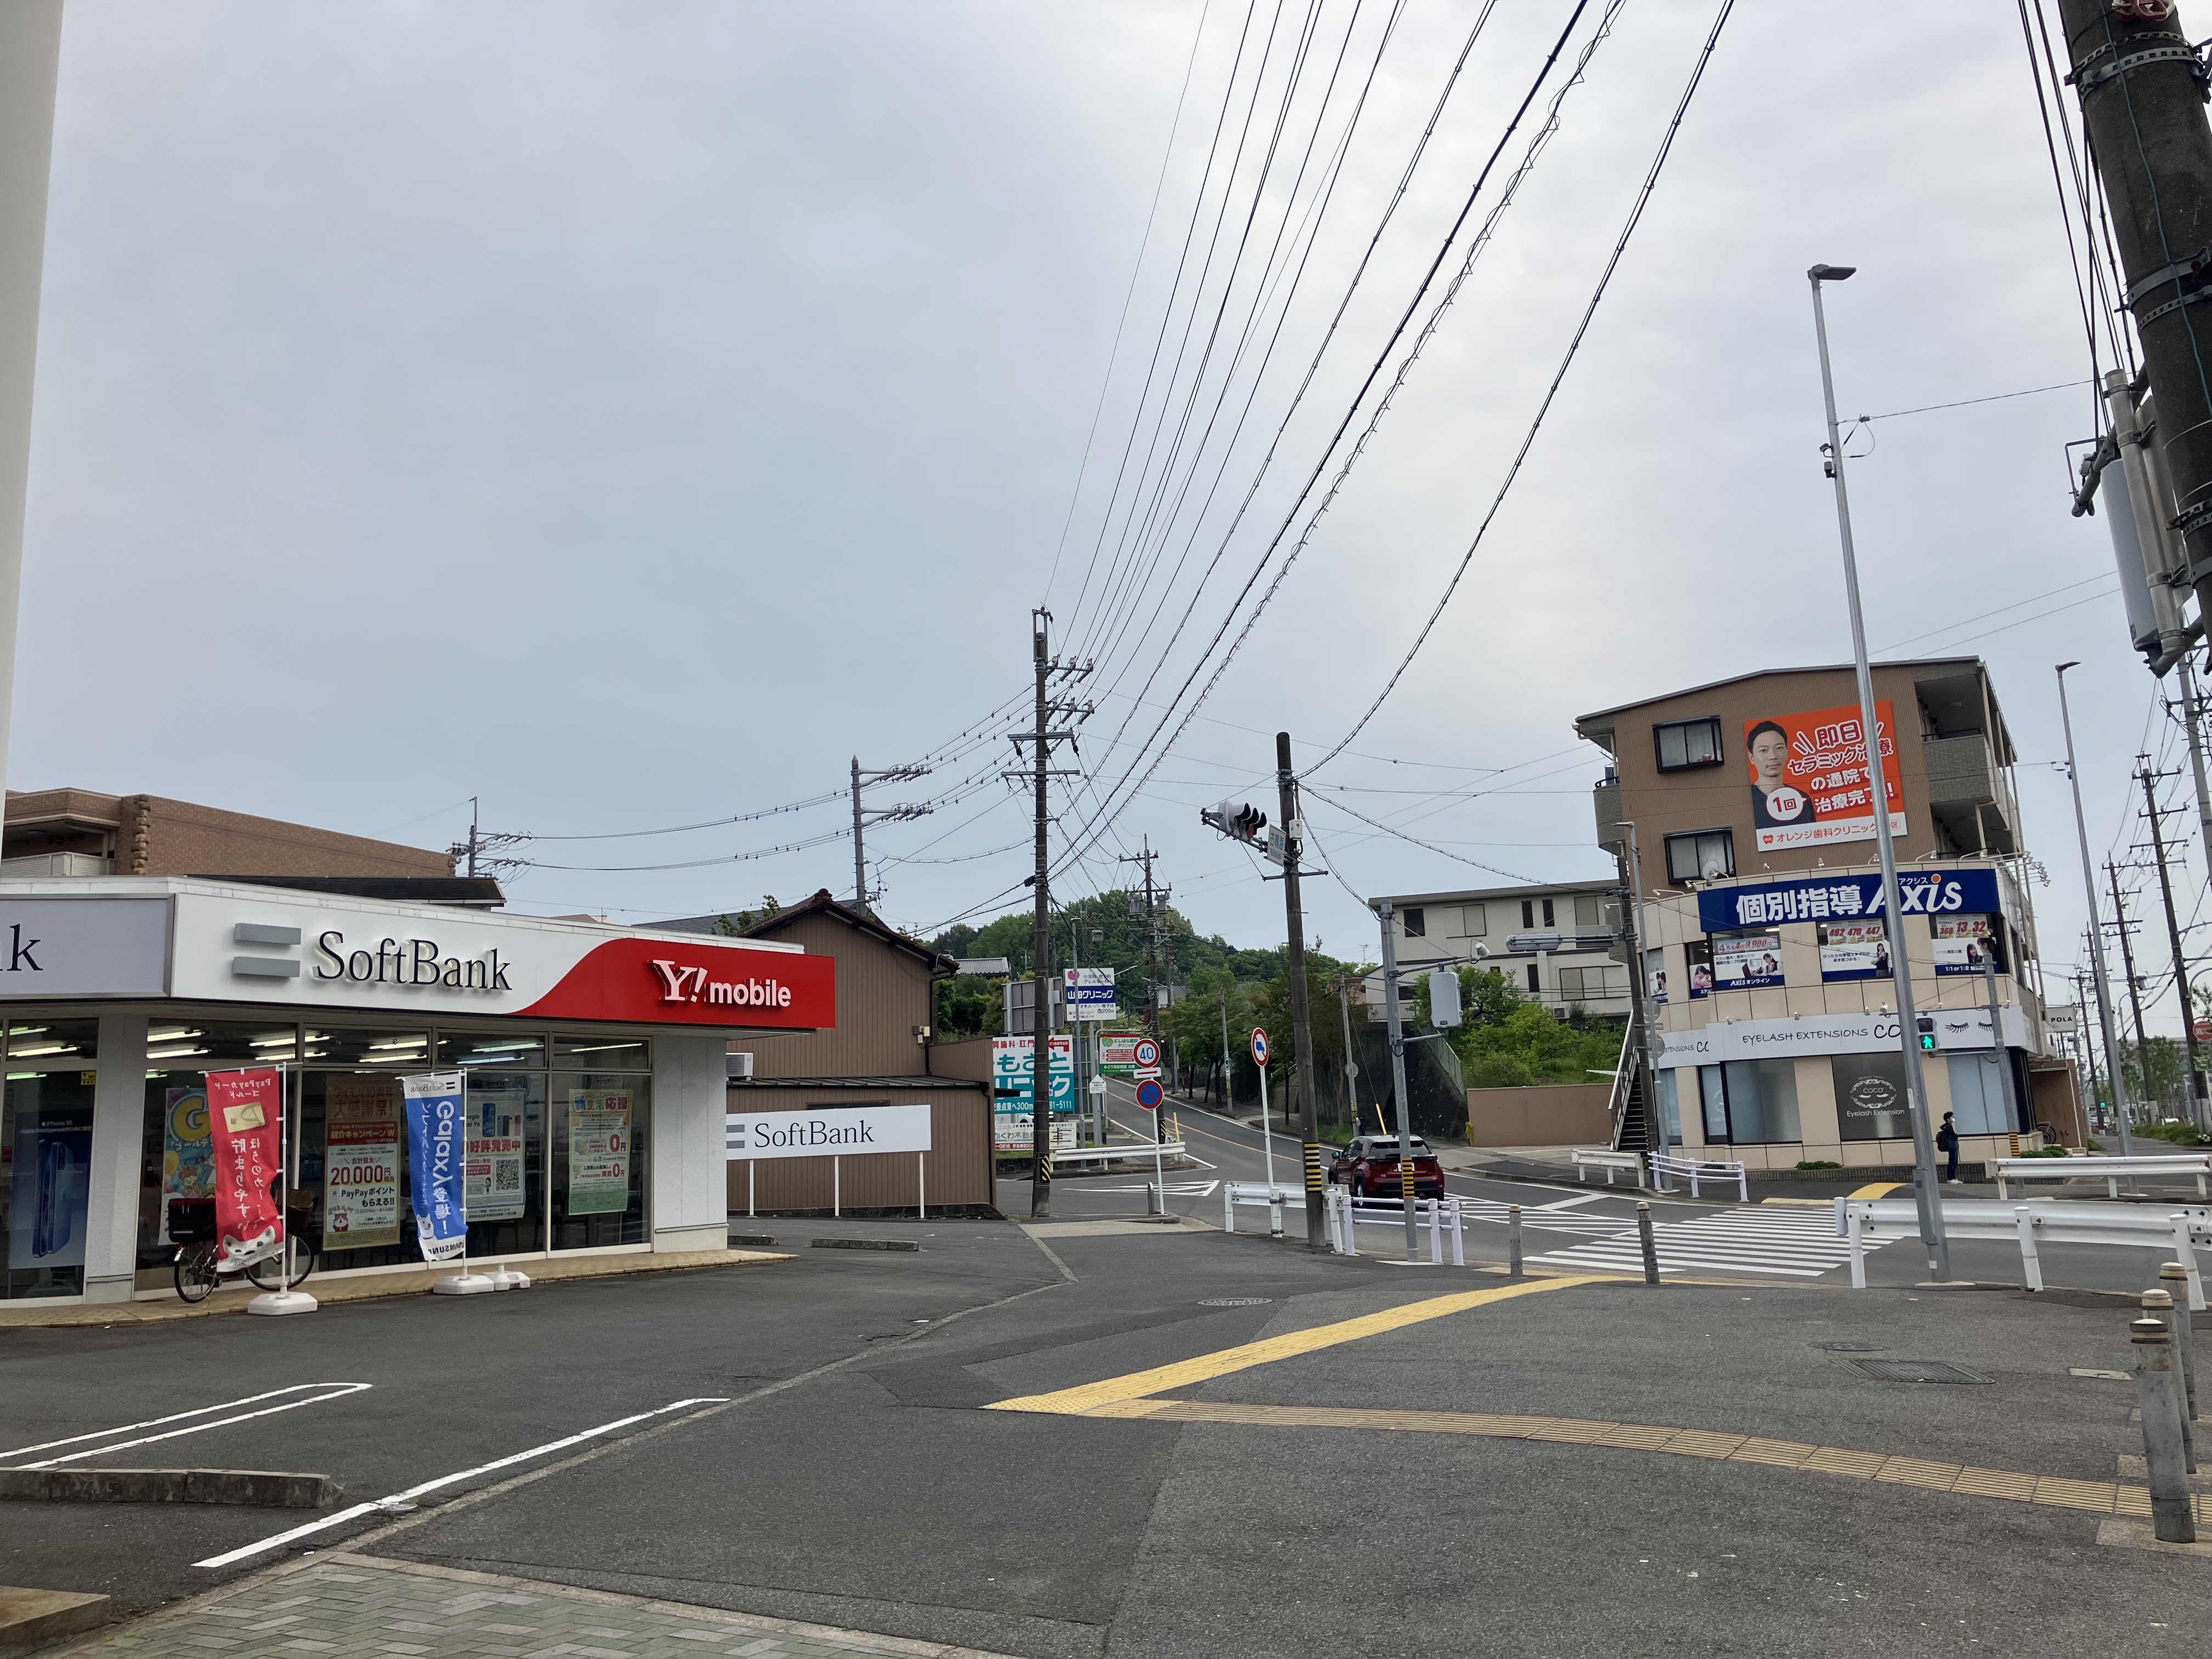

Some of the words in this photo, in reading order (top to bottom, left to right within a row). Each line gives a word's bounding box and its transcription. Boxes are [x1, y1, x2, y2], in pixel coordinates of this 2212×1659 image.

[1815, 719, 1862, 750] 即日
[1771, 795, 1798, 814] 1回
[1898, 877, 1928, 885] アクシス
[1736, 885, 1863, 926] 個別指導
[1829, 928, 1846, 937] 462
[1847, 927, 1862, 936] 470
[1865, 926, 1881, 935] 447
[1956, 921, 1968, 933] 13
[1972, 921, 1987, 932] 32
[317, 930, 513, 991] SoftBank
[1742, 1032, 1793, 1045] EYELASH
[1796, 1028, 1868, 1040] EXTENSIONS
[1874, 1025, 1902, 1039] CO
[1139, 1047, 1154, 1060] 40
[1665, 1045, 1694, 1053] XTENSIONS
[334, 1099, 393, 1118] 大感謝祭!
[994, 1102, 1034, 1111] 差点東へ300m
[754, 1119, 875, 1148] SoftBank
[341, 1186, 394, 1199] PayPayポイント
